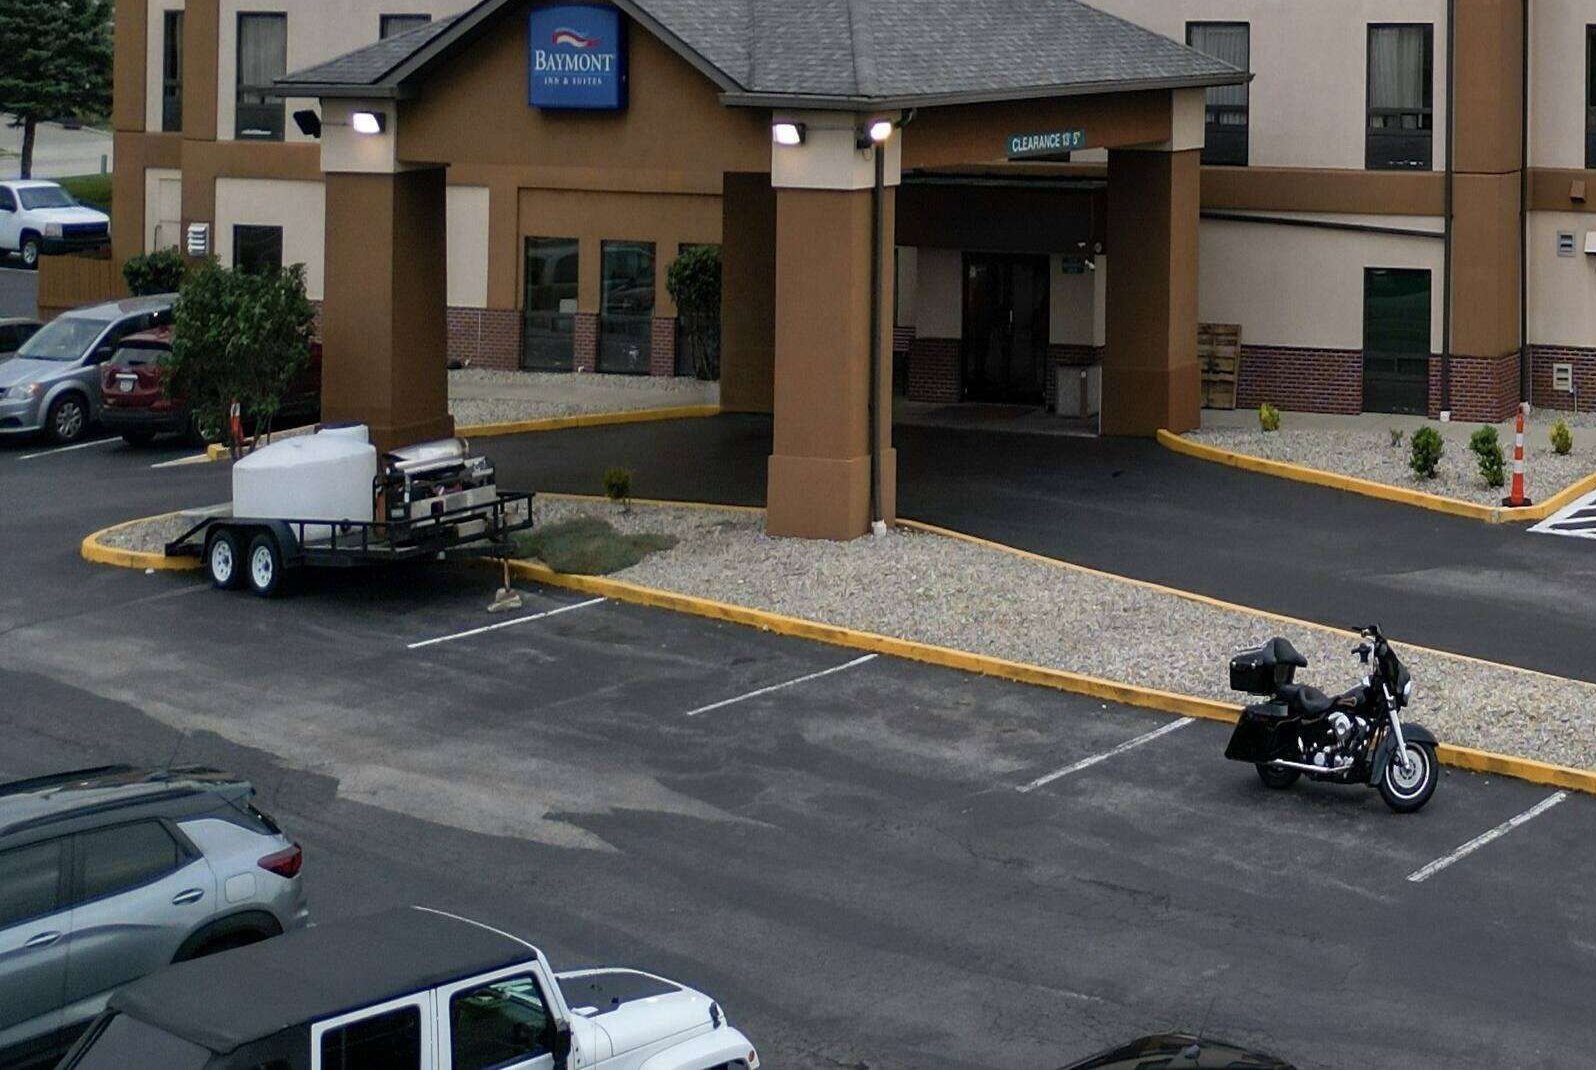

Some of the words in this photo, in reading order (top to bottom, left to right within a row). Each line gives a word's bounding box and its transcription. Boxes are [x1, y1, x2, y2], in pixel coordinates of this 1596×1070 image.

[535, 49, 613, 72] BAYMONT
[544, 76, 559, 85] INN
[572, 76, 602, 85] SUITES
[1012, 133, 1060, 152] CLEARANCE
